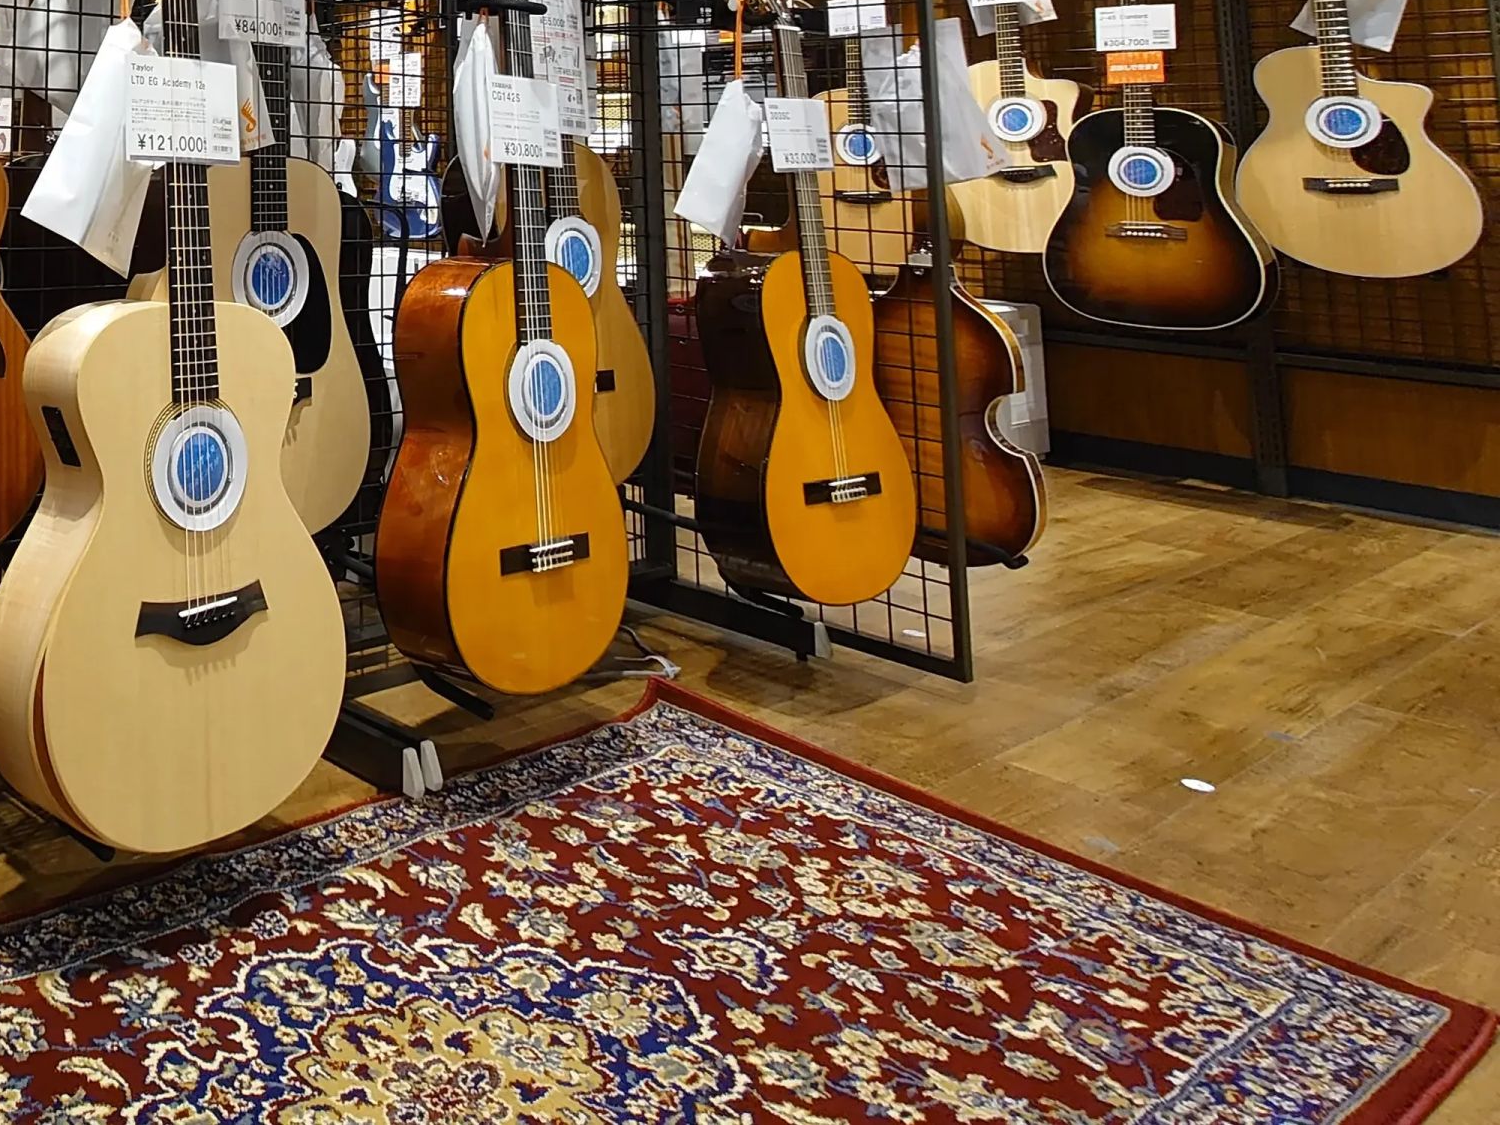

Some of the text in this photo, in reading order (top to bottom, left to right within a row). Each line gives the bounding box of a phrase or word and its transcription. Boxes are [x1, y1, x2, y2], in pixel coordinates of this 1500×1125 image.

[131, 62, 154, 73] Taylor
[131, 75, 146, 86] LTD
[137, 133, 204, 153] ¥121,000
